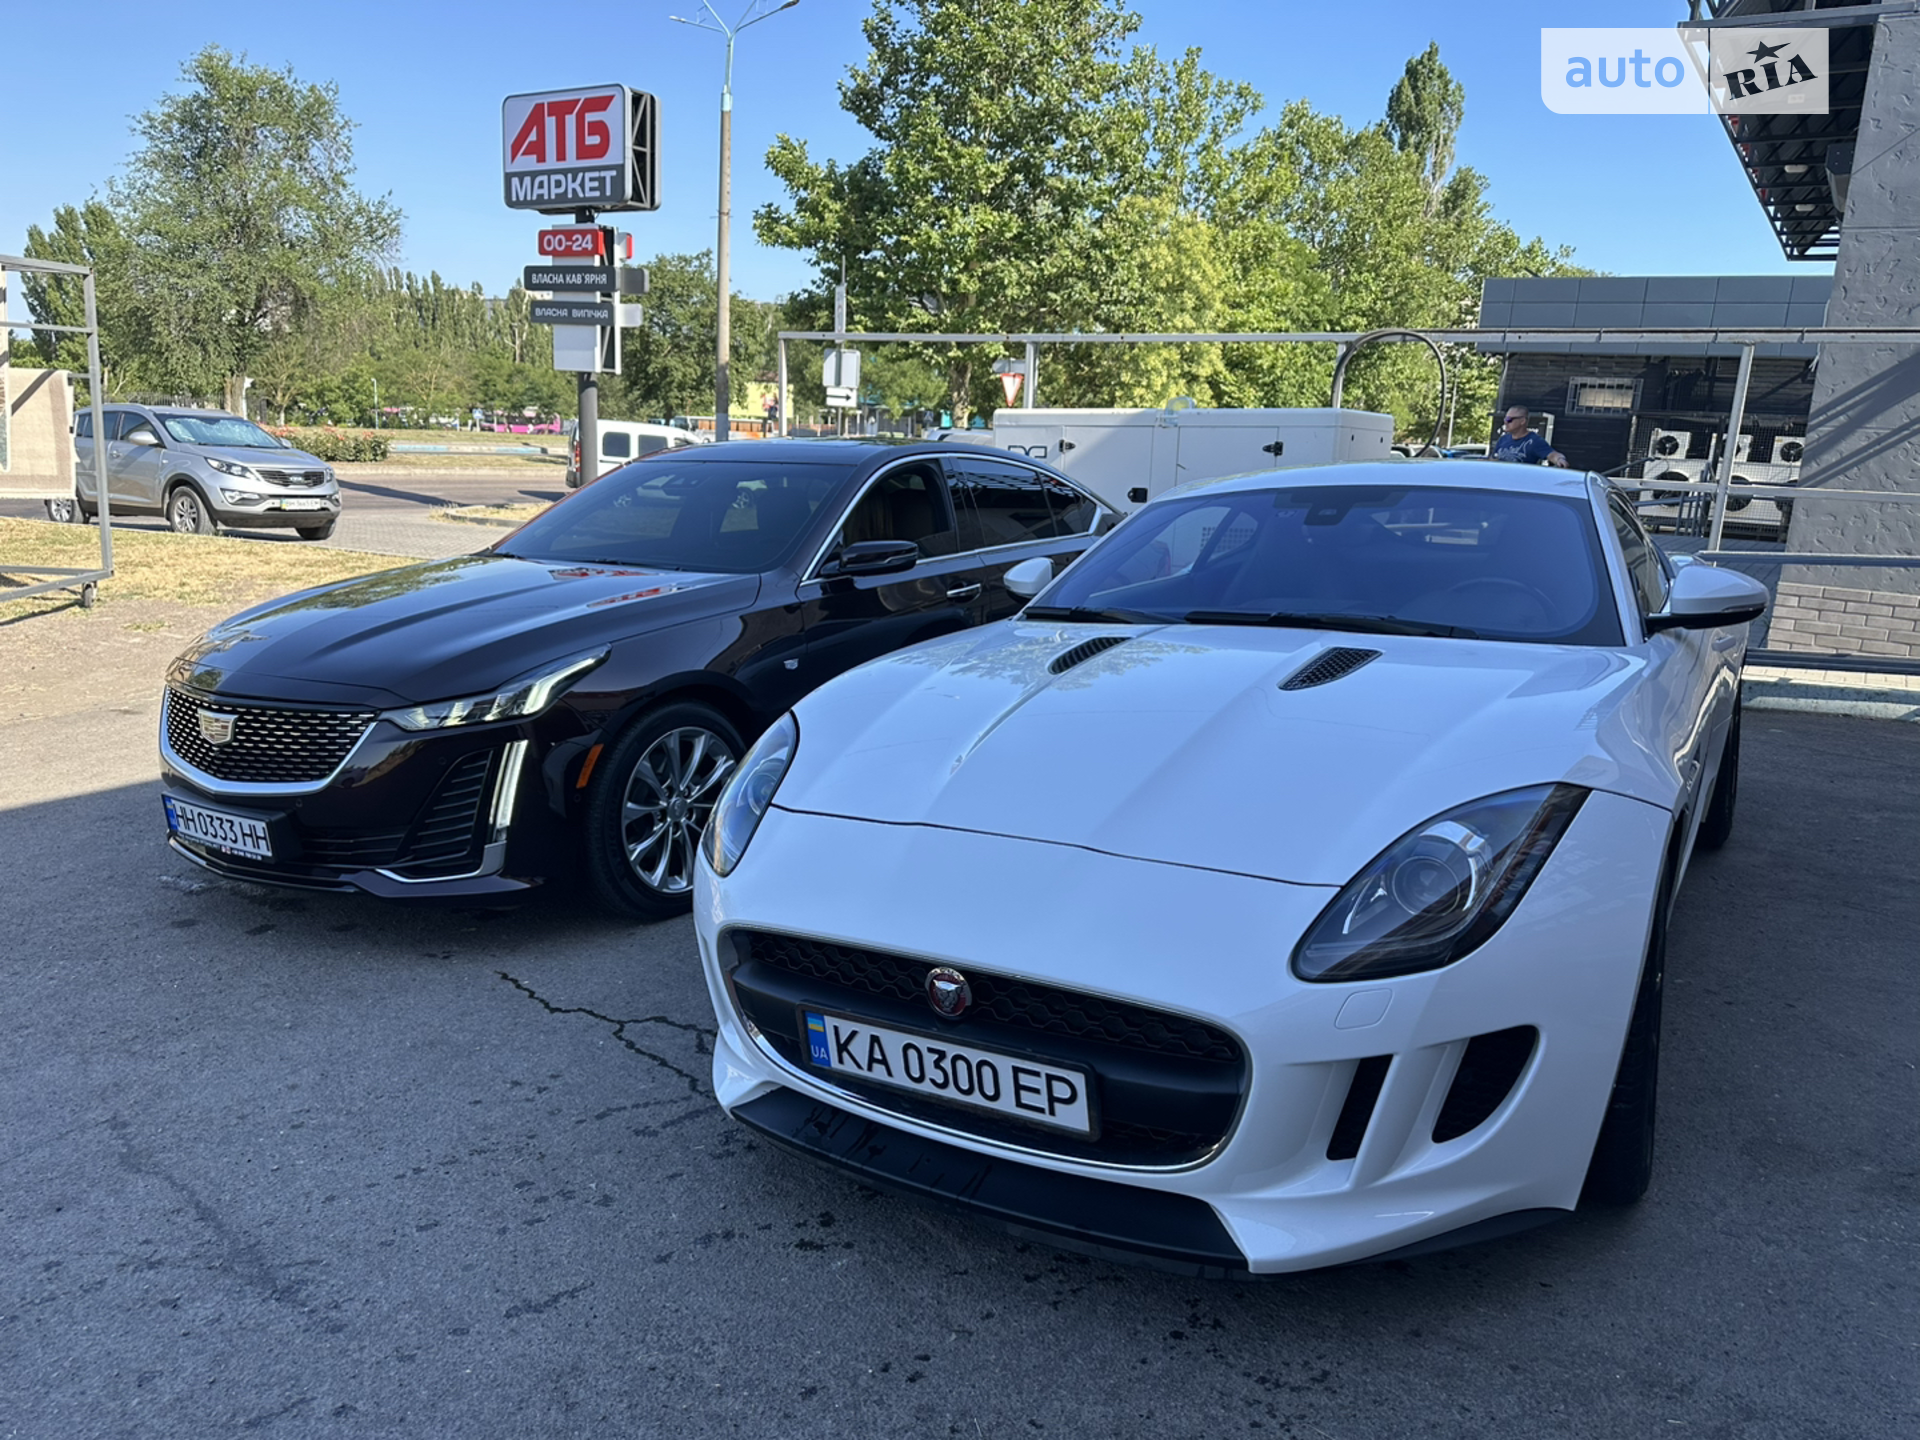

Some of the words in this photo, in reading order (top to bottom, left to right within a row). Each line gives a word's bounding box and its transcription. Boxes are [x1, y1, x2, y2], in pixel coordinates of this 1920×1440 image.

[510, 94, 616, 164] АТБ
[510, 170, 617, 201] МАРКЕТ
[543, 234, 593, 251] 00-24
[531, 272, 565, 284] ВЛАСНА
[534, 307, 569, 318] ВЛАСНА
[571, 308, 609, 319] ВИПІЧКА
[197, 811, 238, 844] 0333
[811, 1044, 829, 1060] UA
[832, 1024, 894, 1078] KA
[902, 1042, 1001, 1102] 0300
[1011, 1064, 1077, 1117] EP
